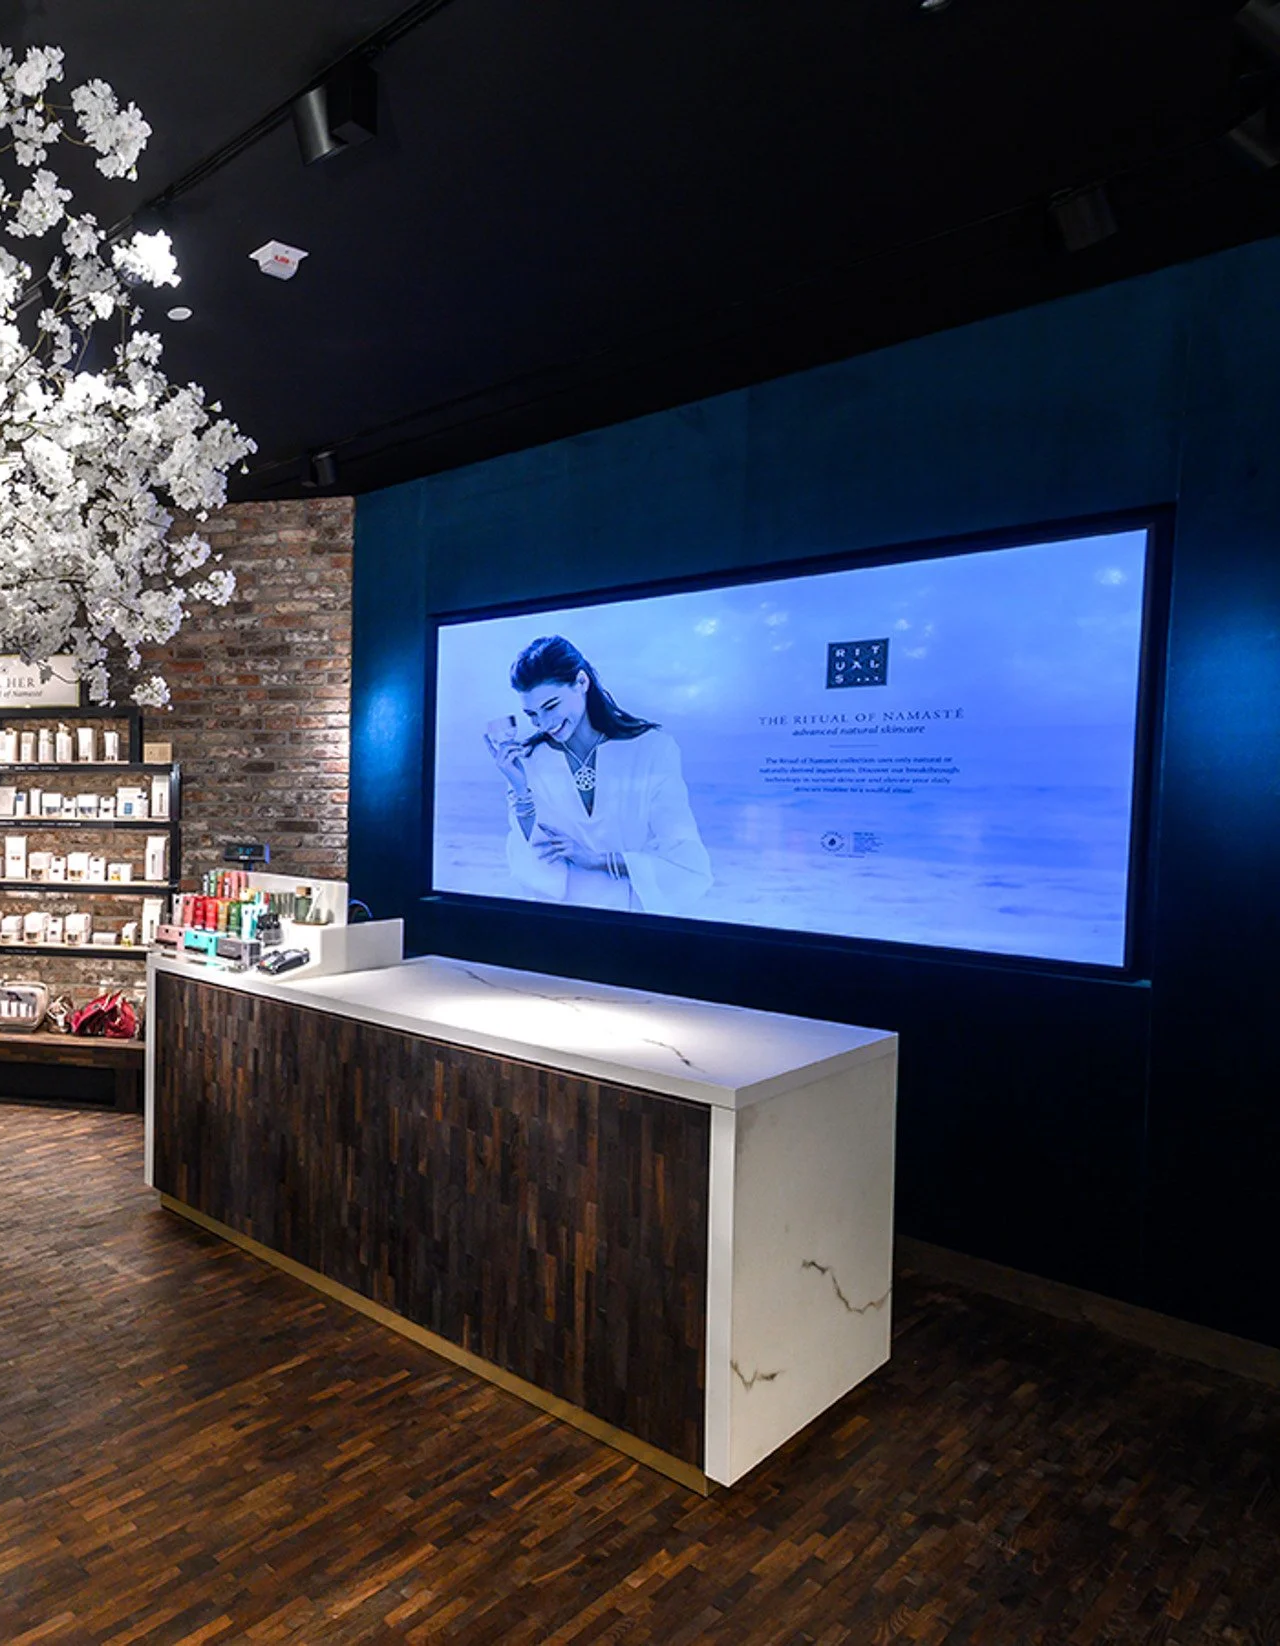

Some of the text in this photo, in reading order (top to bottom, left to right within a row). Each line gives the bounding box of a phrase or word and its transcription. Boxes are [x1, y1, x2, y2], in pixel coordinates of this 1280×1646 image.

[6, 677, 35, 688] HER
[3, 690, 12, 698] of
[758, 707, 964, 726] THE RITUAL OF NAMASTÉ
[792, 725, 926, 737] advanced natural skincare
